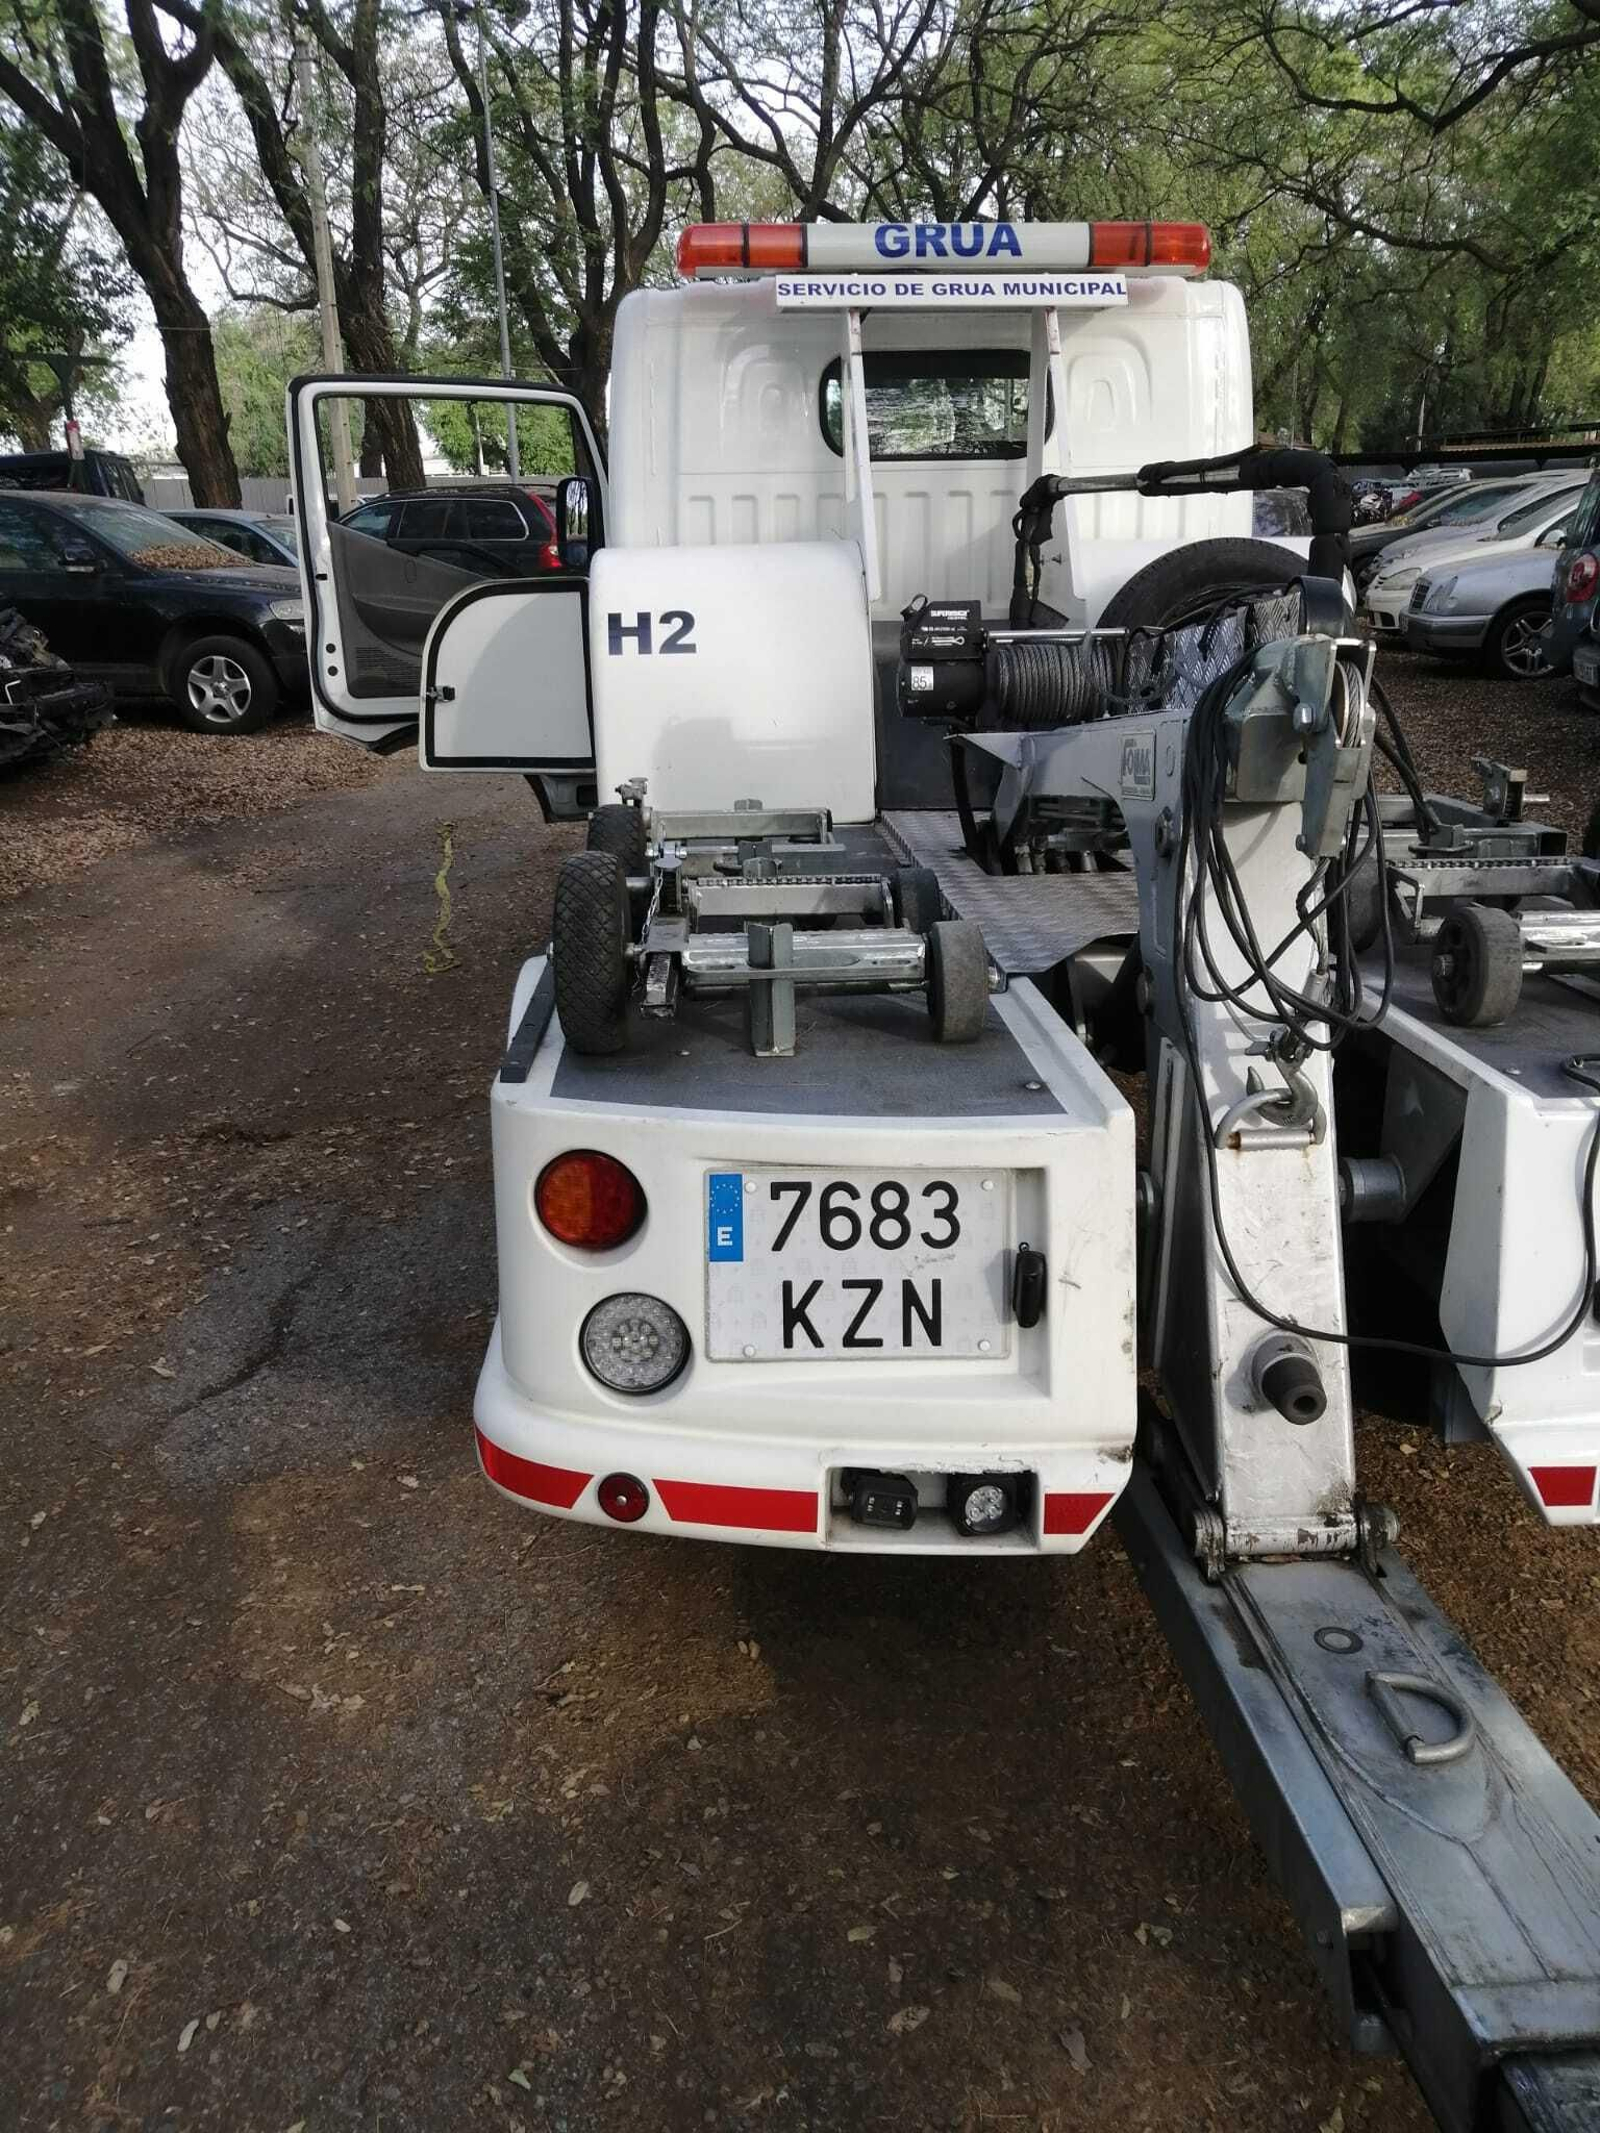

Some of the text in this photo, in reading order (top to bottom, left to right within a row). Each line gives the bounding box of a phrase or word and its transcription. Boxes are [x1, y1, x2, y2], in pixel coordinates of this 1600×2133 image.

[875, 224, 1022, 258] GRUA
[777, 281, 1127, 297] SERVICIO DE GRUA MUNICIPAL
[607, 610, 697, 655] H2
[769, 1180, 961, 1252] 7683
[717, 1226, 733, 1246] E
[782, 1278, 942, 1349] KZN
